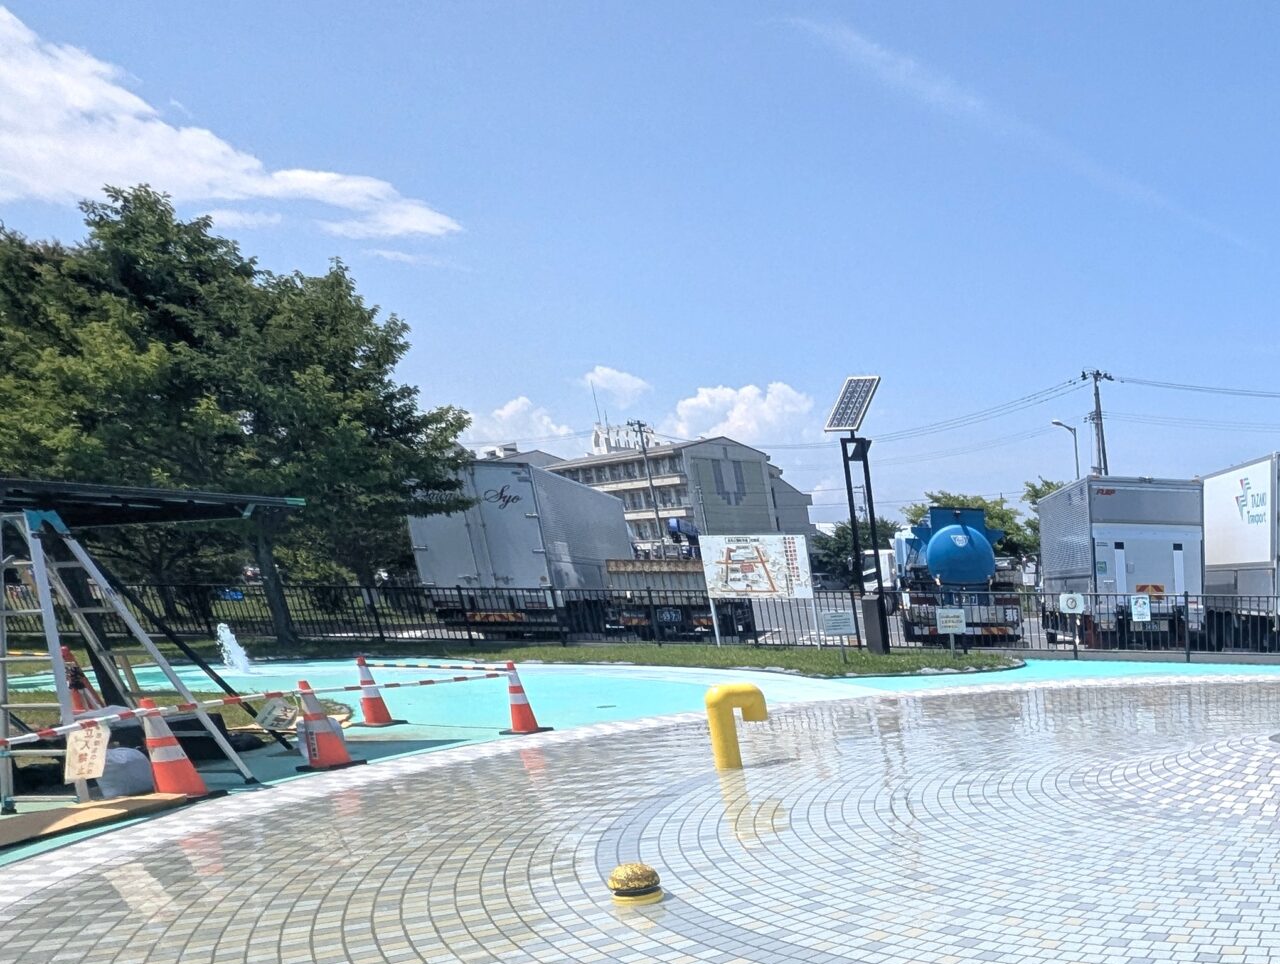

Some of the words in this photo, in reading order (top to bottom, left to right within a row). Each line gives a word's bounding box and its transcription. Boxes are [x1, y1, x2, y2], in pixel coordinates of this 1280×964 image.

[484, 485, 521, 509] Syo
[77, 729, 94, 776] 立入禁止
